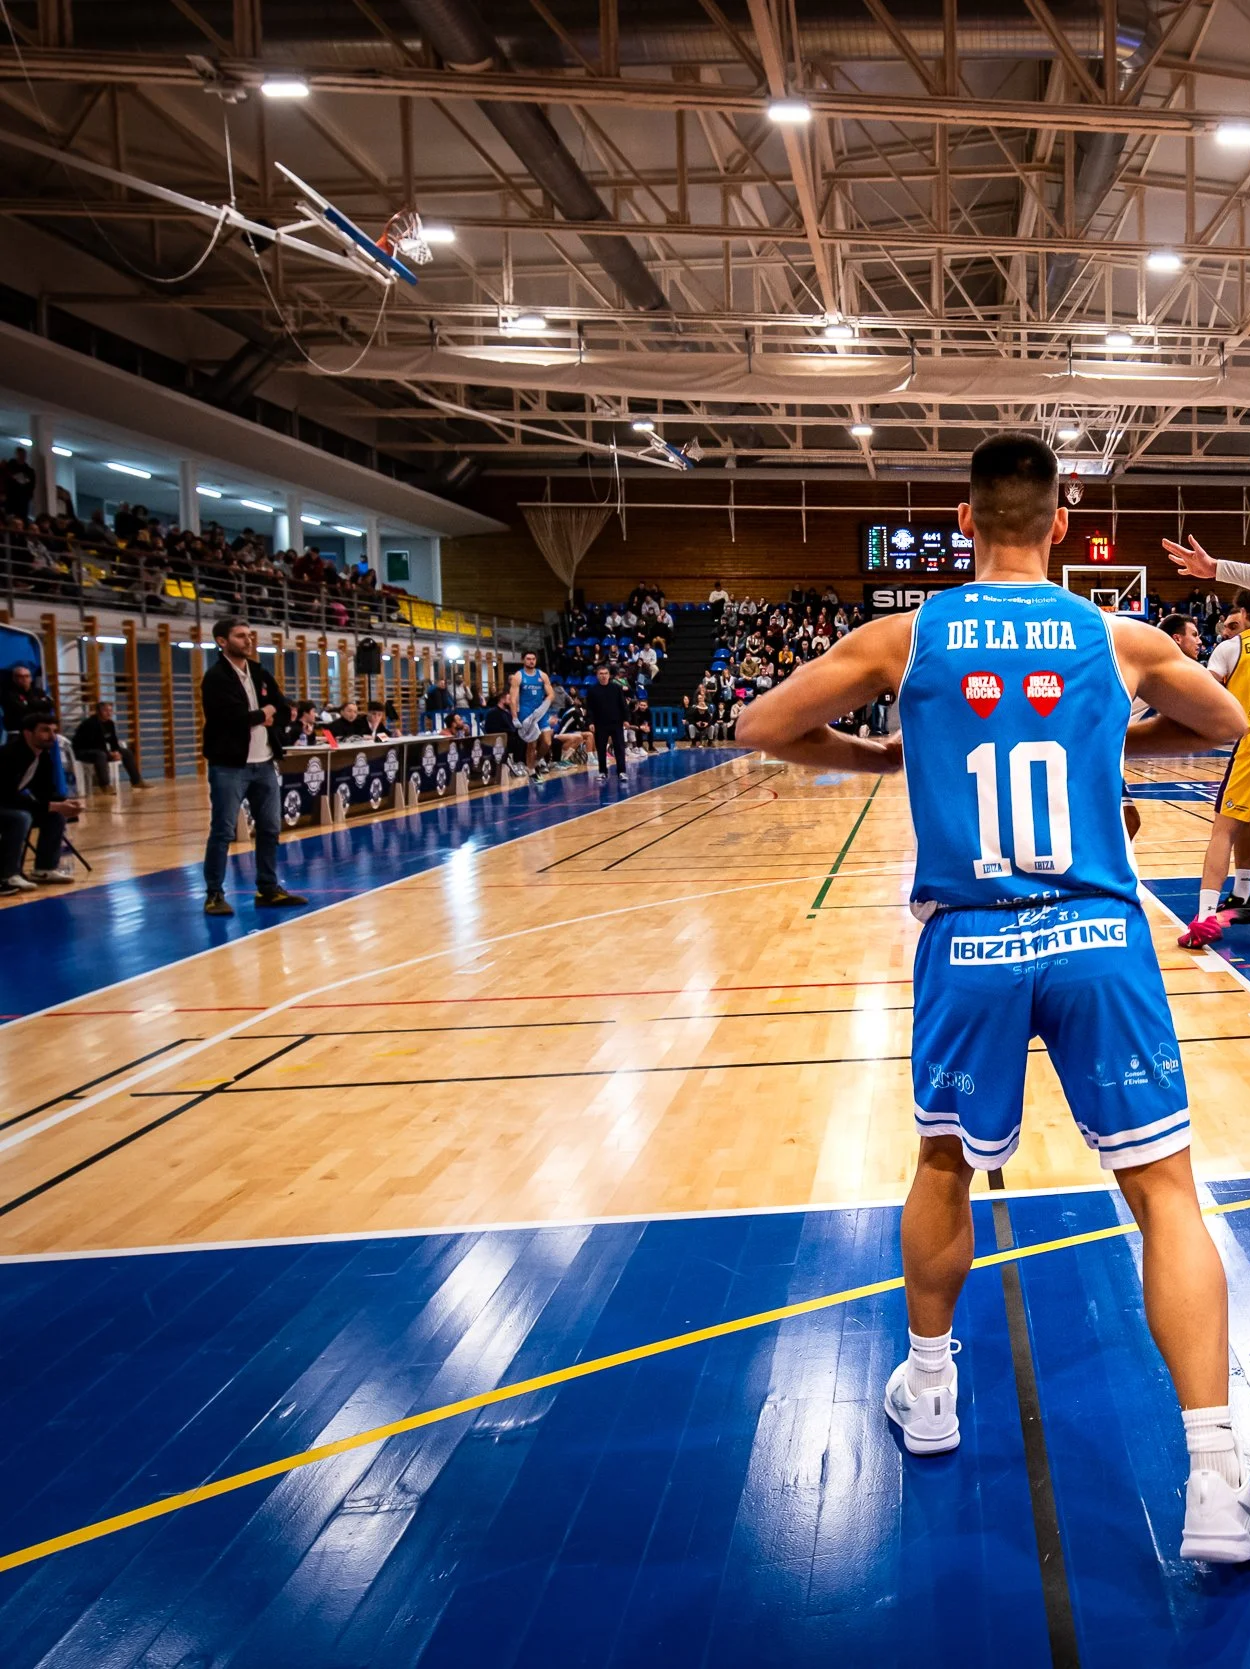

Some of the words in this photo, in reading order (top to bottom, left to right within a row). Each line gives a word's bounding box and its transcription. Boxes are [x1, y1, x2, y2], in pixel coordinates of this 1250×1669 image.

[1093, 545, 1109, 560] 14
[895, 558, 911, 570] 51
[954, 558, 971, 570] 47
[946, 619, 979, 650] DE
[985, 619, 1019, 650] LA
[1025, 618, 1077, 650] RÚA
[967, 676, 998, 688] IBIZA
[1029, 675, 1059, 688] IBIZA
[966, 686, 1001, 699] ROCKS
[1027, 686, 1062, 698] ROCKS
[966, 740, 1074, 880] 10
